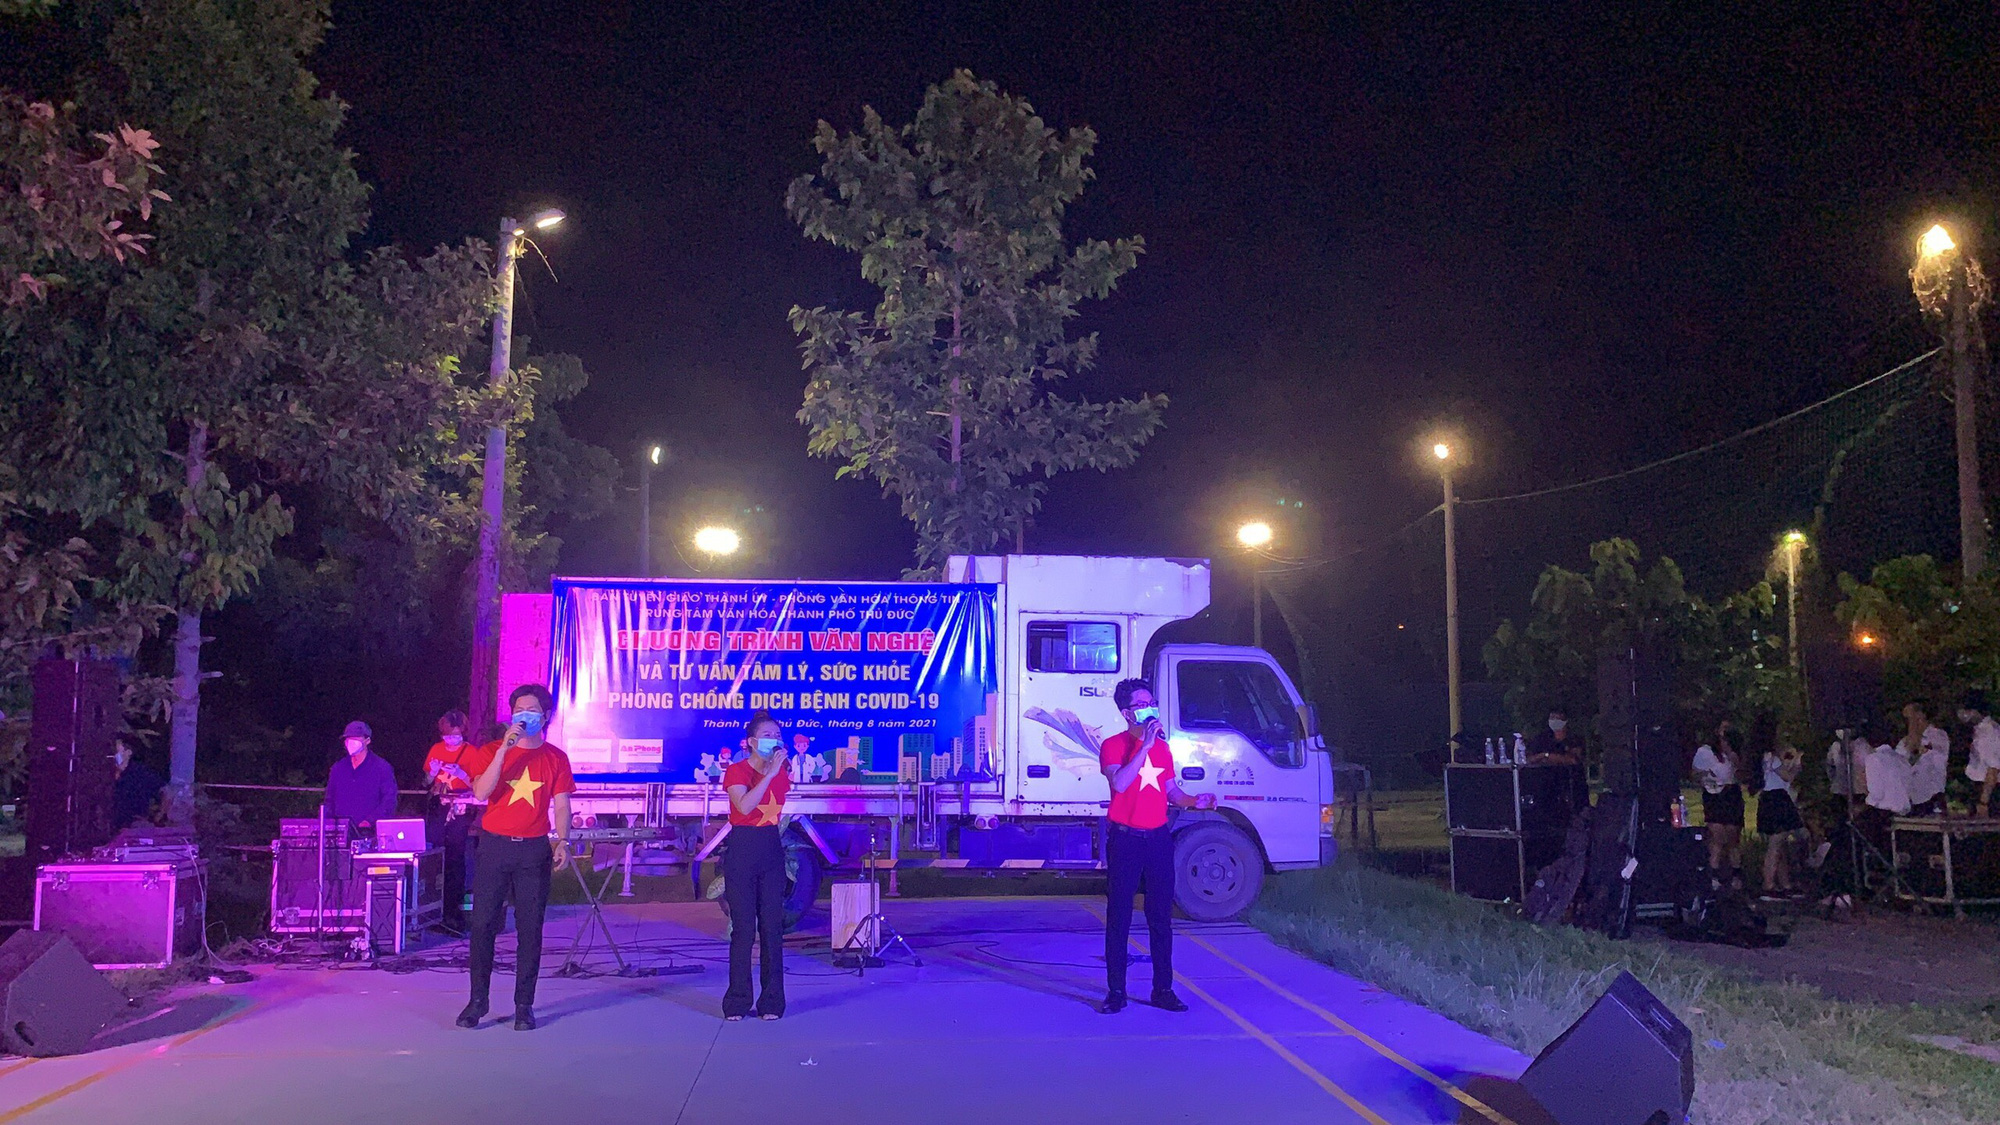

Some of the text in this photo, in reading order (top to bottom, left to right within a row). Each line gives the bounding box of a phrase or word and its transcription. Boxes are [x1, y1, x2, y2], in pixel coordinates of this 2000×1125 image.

[779, 592, 826, 604] PHÒNG
[830, 592, 857, 604] VĂN
[894, 593, 938, 604] THÔNG
[686, 607, 713, 619] TÂM
[717, 607, 745, 619] VĂN
[748, 607, 777, 619] HÓA
[828, 606, 856, 620] PHỐ
[859, 607, 883, 620] THỦ
[886, 607, 915, 620] ĐỨC
[727, 627, 804, 652] TRÌNH
[808, 627, 861, 652] VĂN
[866, 627, 936, 656] NGHỆ
[639, 660, 663, 680] VÀ
[669, 662, 695, 681] TƯ
[742, 661, 782, 681] TÂM
[787, 661, 814, 683] LÝ,
[820, 661, 858, 681] SỨC
[863, 659, 911, 681] KHỎE
[1079, 686, 1113, 697] ISU
[608, 688, 673, 709] PHÒNG
[679, 686, 745, 710] CHỐNG
[800, 689, 850, 713] BỆNH
[855, 692, 940, 710] COVID-19
[703, 719, 740, 728] Thành
[776, 718, 792, 728] hủ
[796, 718, 824, 729] Đức,
[828, 718, 864, 730] tháng
[867, 719, 875, 728] 8
[878, 718, 905, 728] năm
[908, 719, 937, 728] 2021
